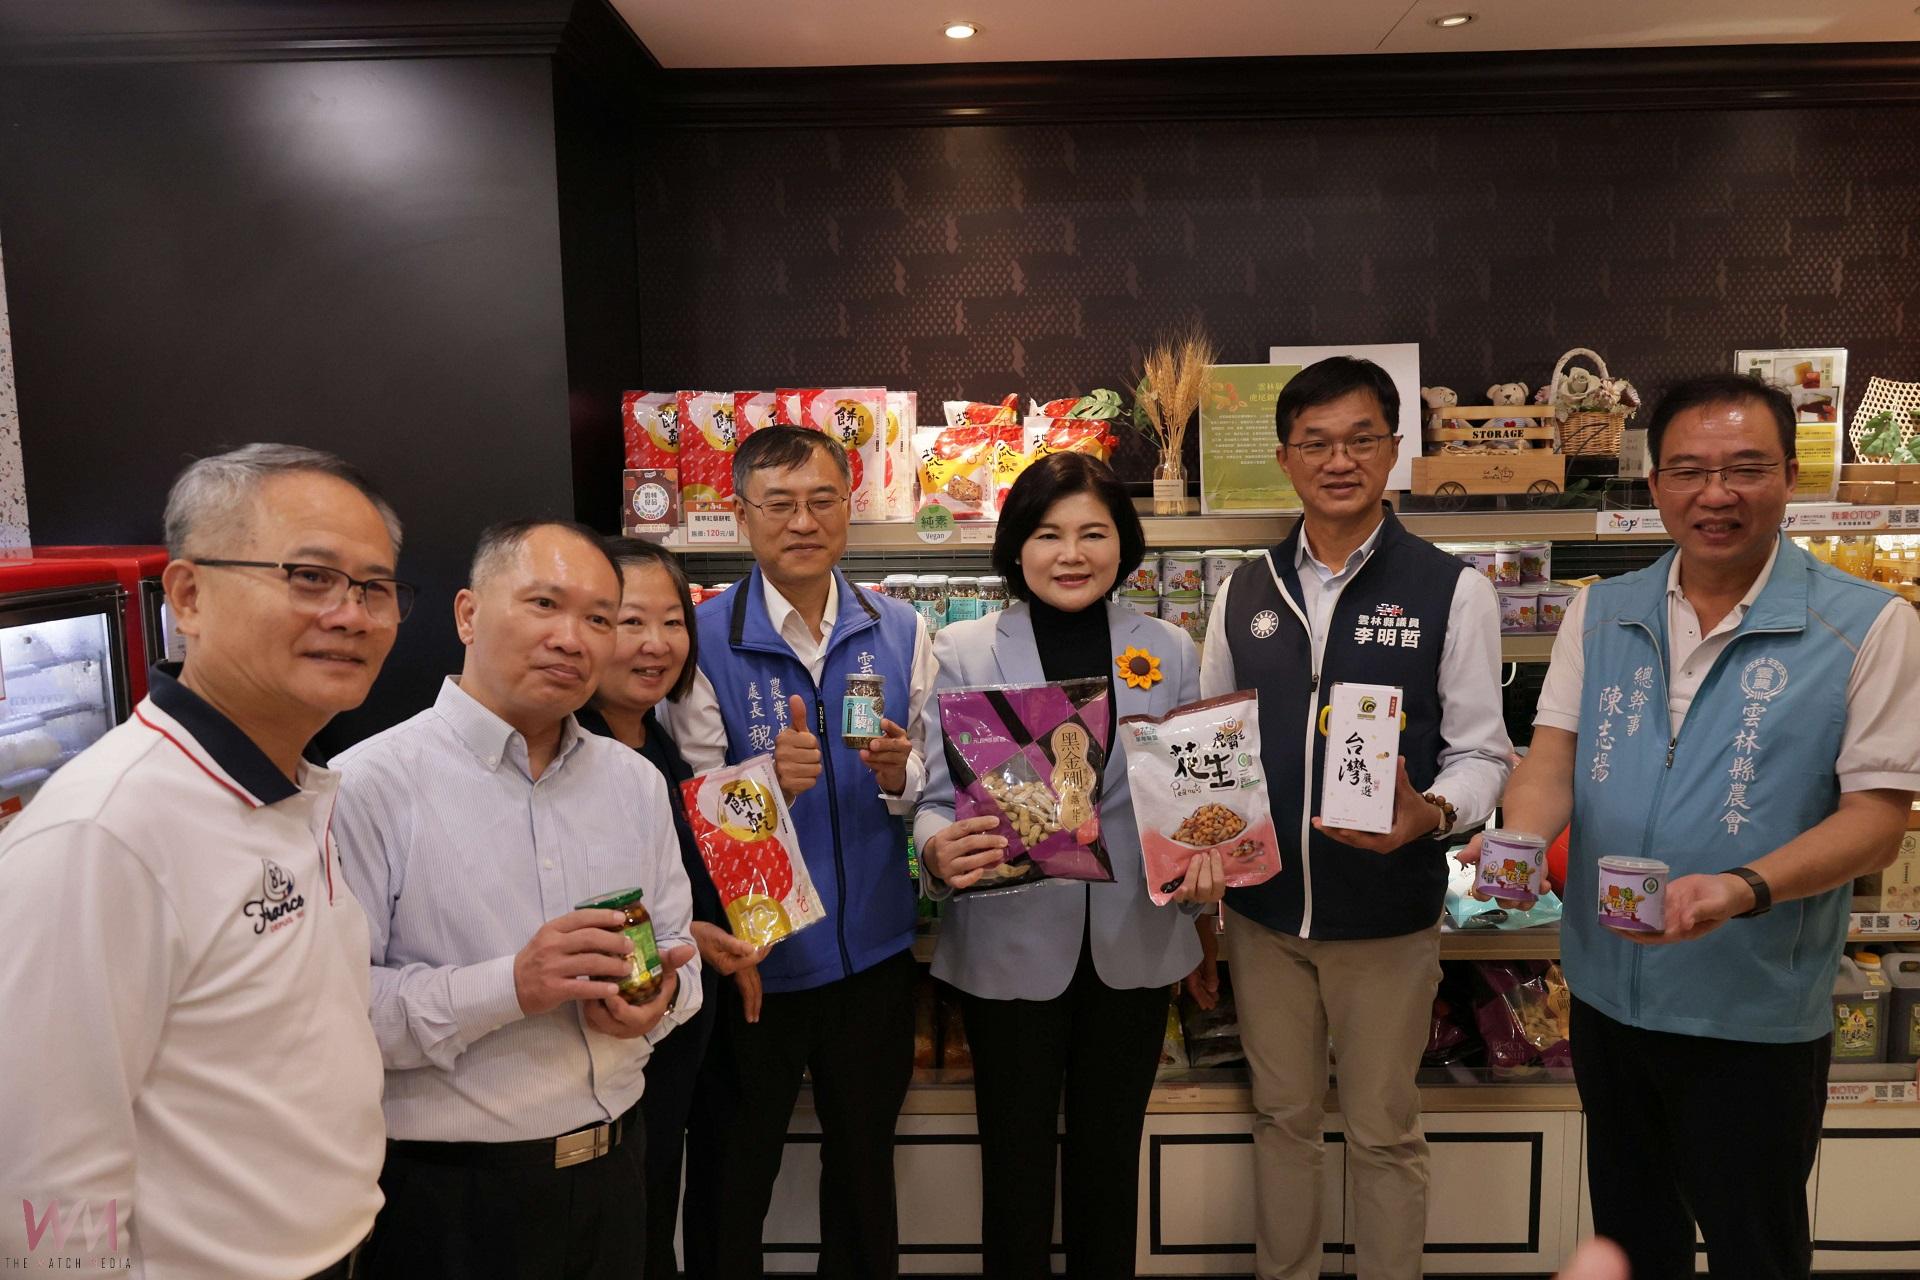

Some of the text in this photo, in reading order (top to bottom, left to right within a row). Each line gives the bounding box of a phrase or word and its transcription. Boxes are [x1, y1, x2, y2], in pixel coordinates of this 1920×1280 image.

[1472, 429, 1525, 439] STORAGE
[920, 514, 948, 529] 純素
[925, 532, 945, 541] Vegan
[1354, 627, 1421, 649] 李明哲
[1357, 614, 1420, 628] 雲林縣議員
[747, 682, 766, 719] 處長
[1625, 666, 1654, 737] 總幹事
[748, 724, 776, 751] 魏
[1591, 685, 1624, 783] 陳志揚
[1061, 732, 1082, 789] 黑金剛
[1170, 741, 1236, 789] 花生
[1338, 731, 1369, 786] 台灣
[1720, 702, 1767, 836] 雲林縣農會
[1170, 781, 1202, 798] Peanuts
[724, 788, 774, 834] 餅乾
